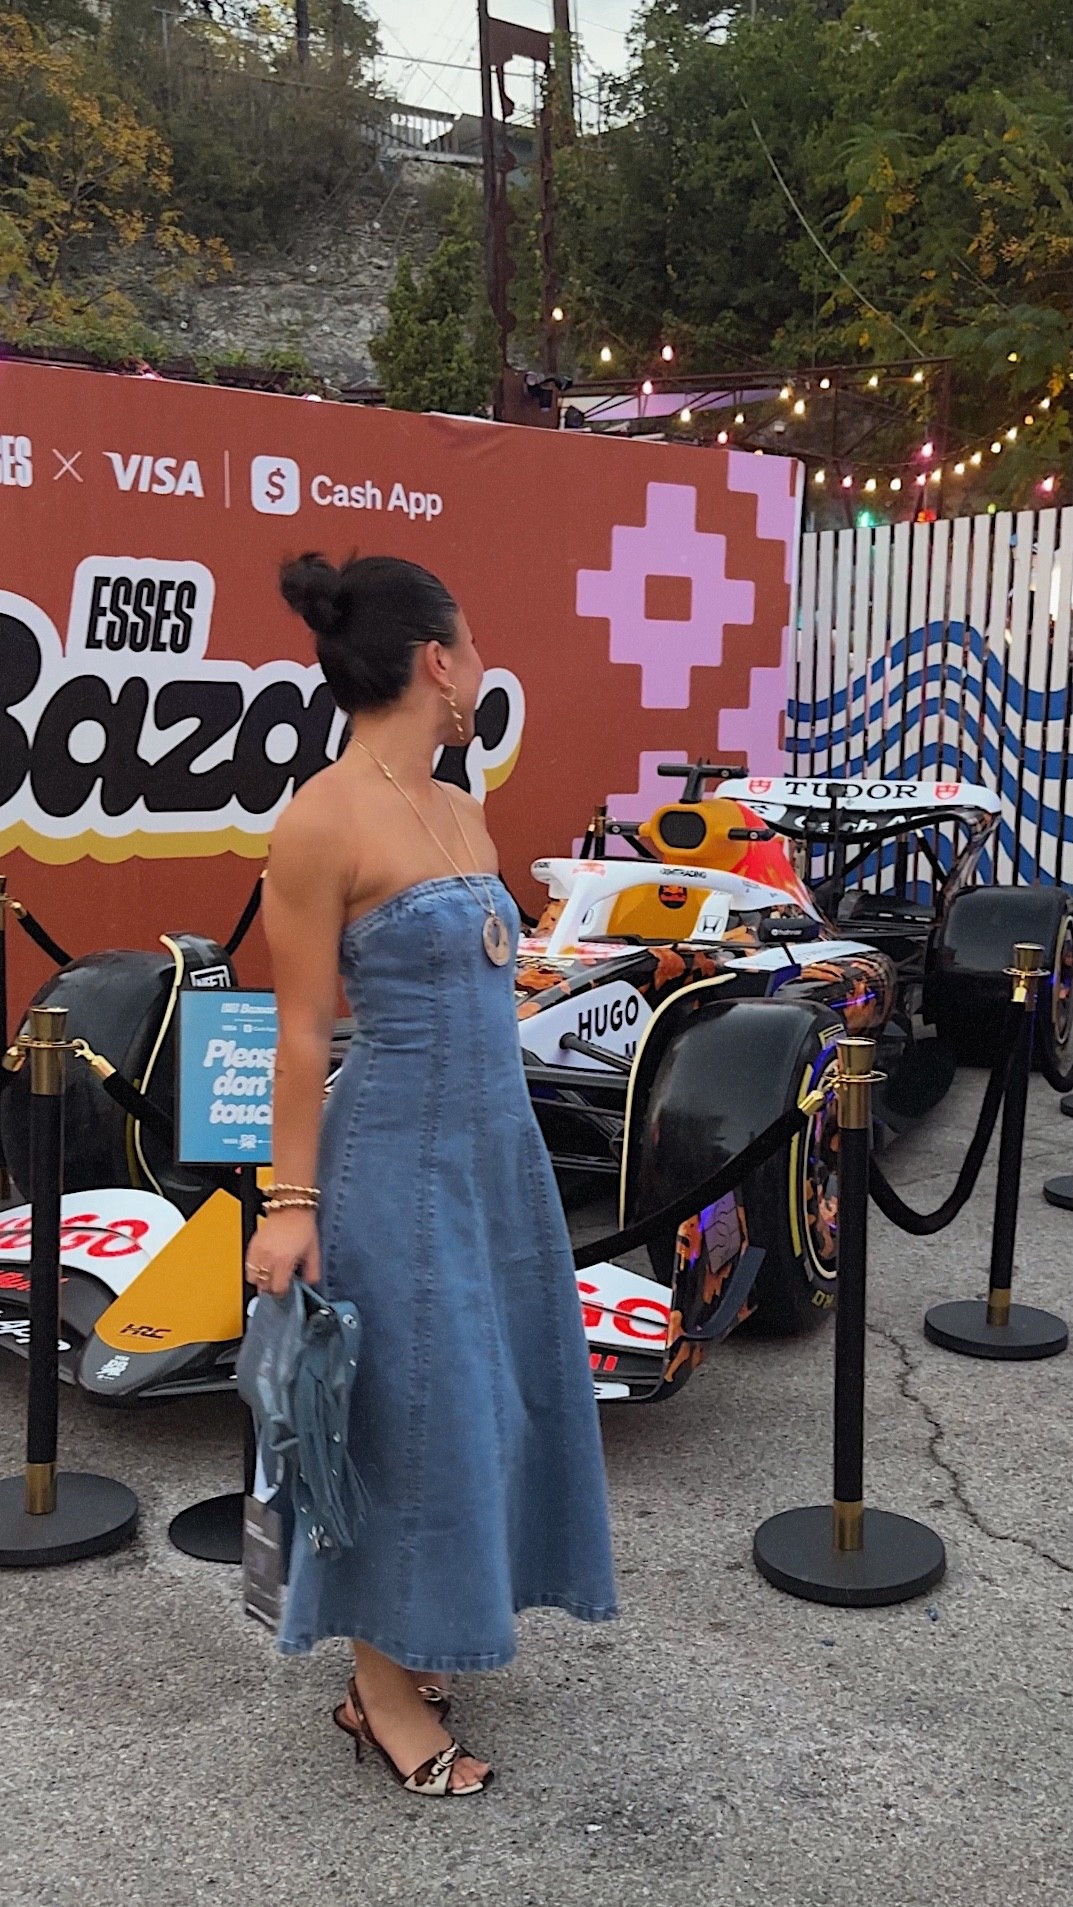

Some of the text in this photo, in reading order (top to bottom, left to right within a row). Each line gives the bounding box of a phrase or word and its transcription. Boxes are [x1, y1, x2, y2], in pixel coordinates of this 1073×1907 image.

[102, 451, 205, 498] VISA
[311, 474, 383, 511] Cash
[387, 482, 444, 522] App
[85, 575, 197, 654] ESSES
[0, 609, 510, 819] azar
[785, 780, 918, 800] TUDOR
[578, 994, 640, 1041] HUGO
[203, 1038, 277, 1069] Pleas
[213, 1068, 275, 1097] don'
[209, 1099, 274, 1125] touc
[120, 1323, 172, 1339] HRC
